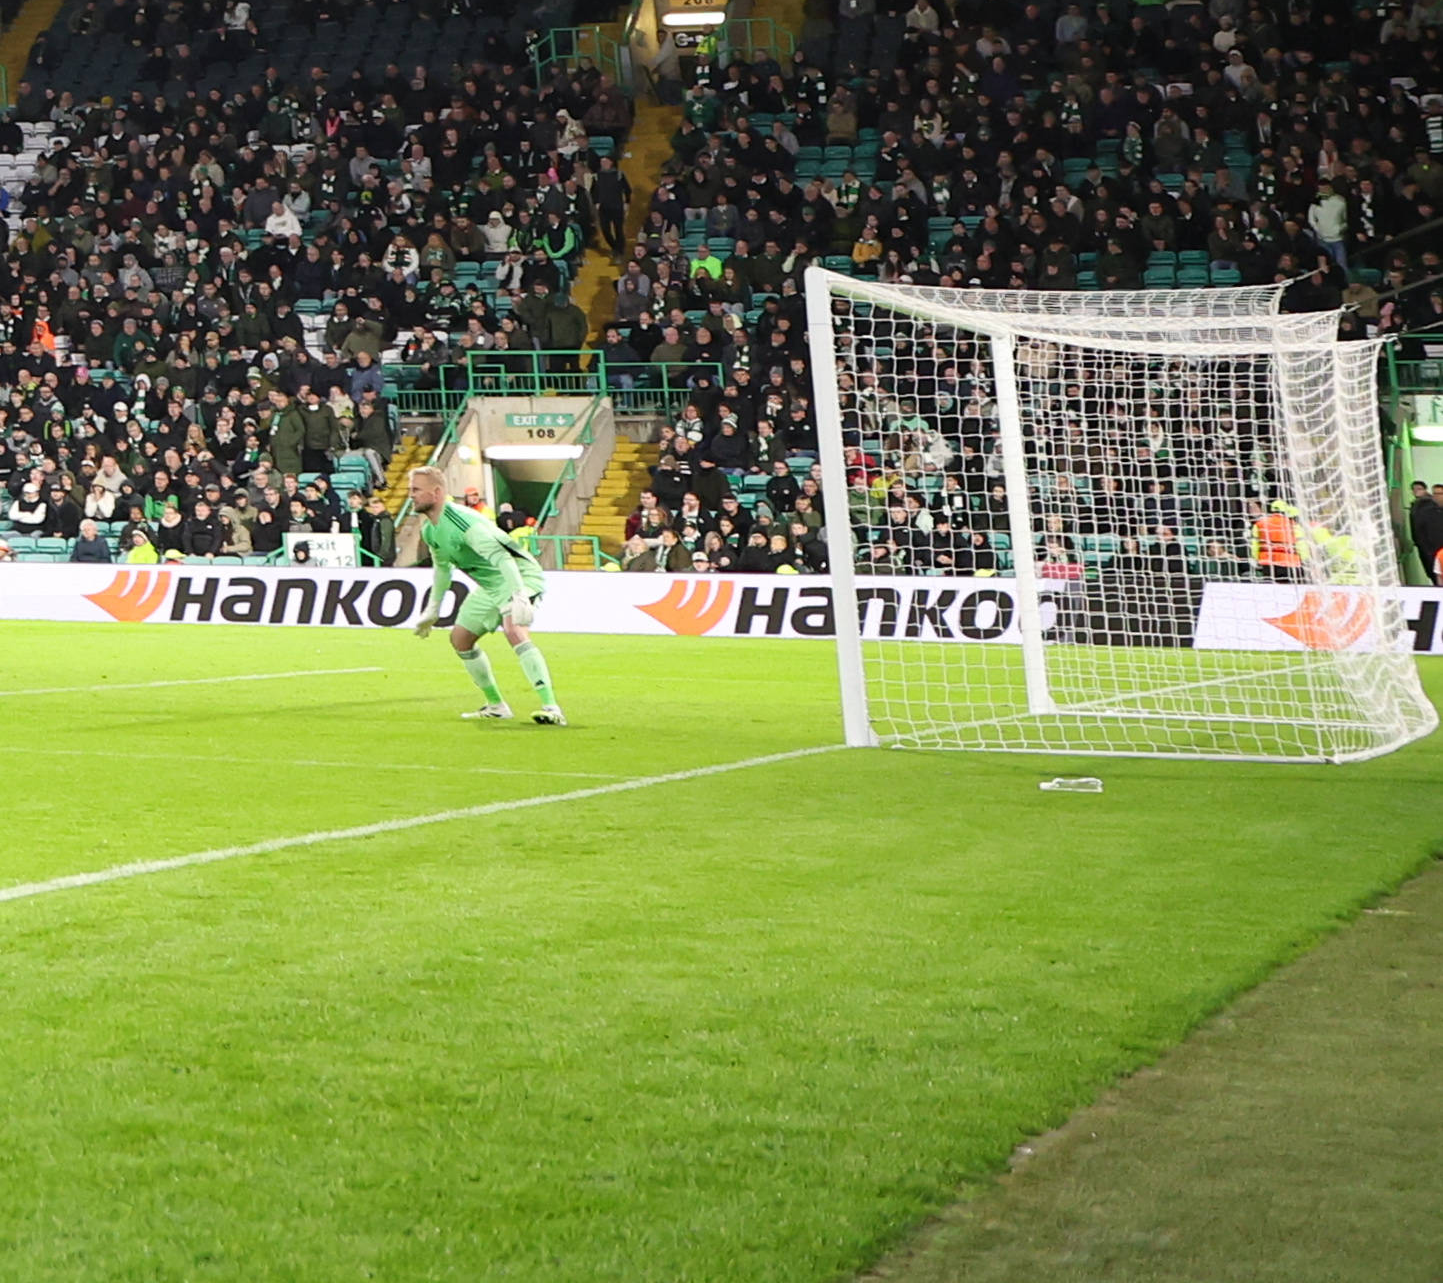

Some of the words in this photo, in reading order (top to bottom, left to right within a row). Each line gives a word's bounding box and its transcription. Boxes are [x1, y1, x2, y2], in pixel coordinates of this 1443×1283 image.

[513, 415, 537, 426] EXIT
[527, 429, 556, 438] 108
[336, 555, 353, 567] 12
